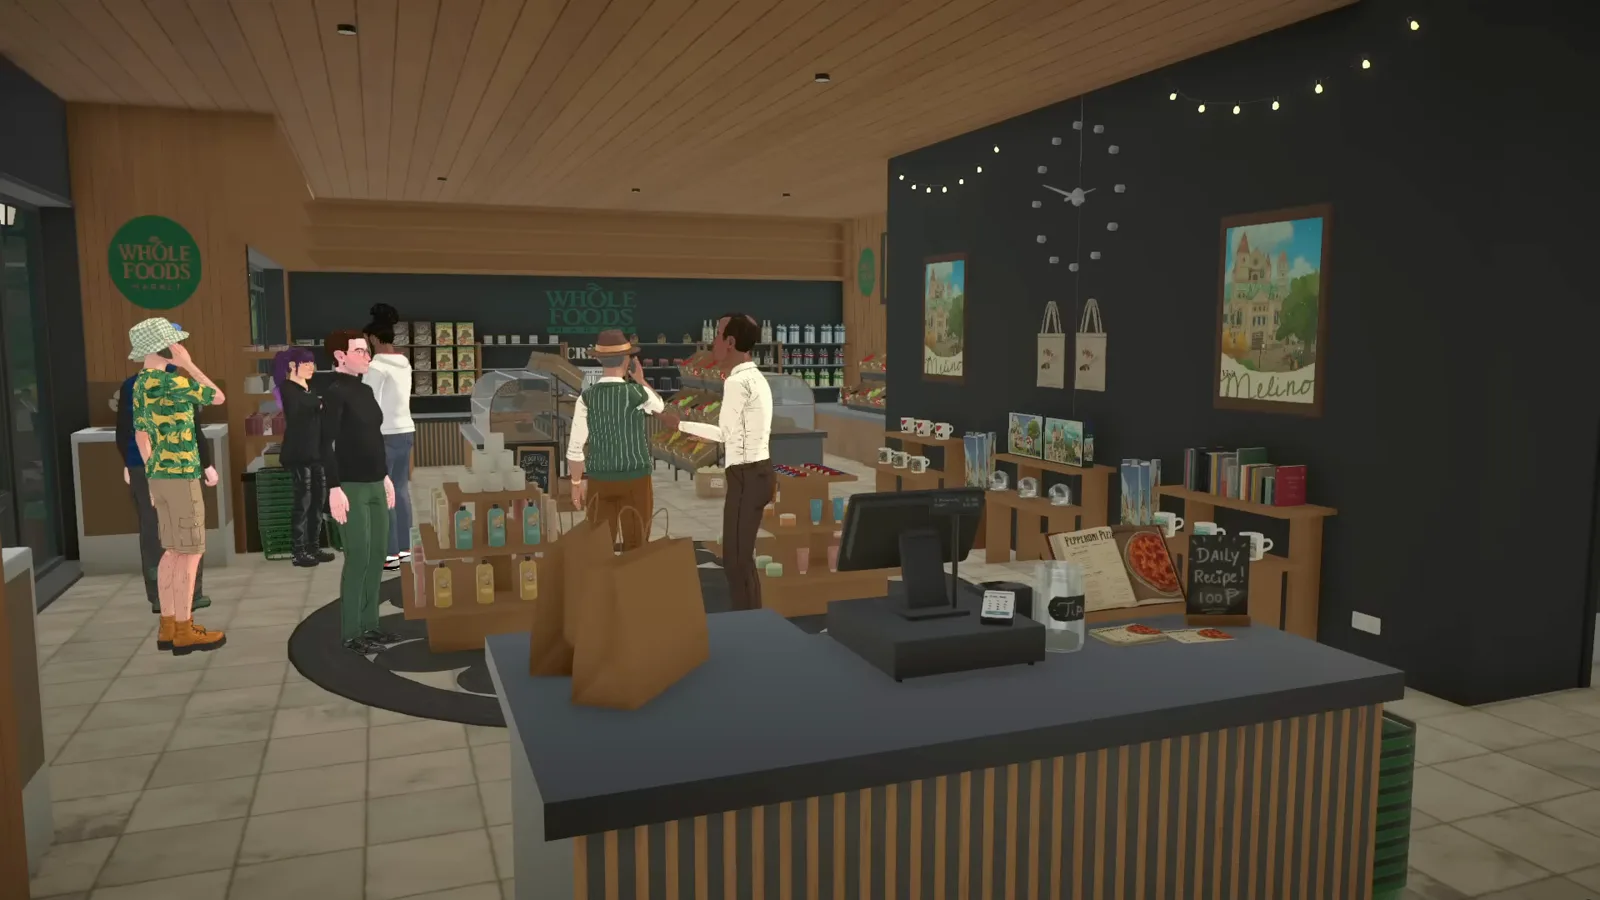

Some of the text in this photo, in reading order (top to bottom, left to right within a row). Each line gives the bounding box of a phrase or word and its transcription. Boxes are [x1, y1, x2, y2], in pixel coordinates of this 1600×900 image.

[118, 243, 191, 262] WHOLE
[122, 262, 191, 280] FOODS
[545, 289, 637, 308] WHOLE
[549, 308, 634, 326] FOODS
[1220, 373, 1315, 399] Melino
[1064, 533, 1099, 547] PEPPERONI
[1196, 547, 1241, 567] DAILY
[1194, 566, 1244, 587] Recipe!
